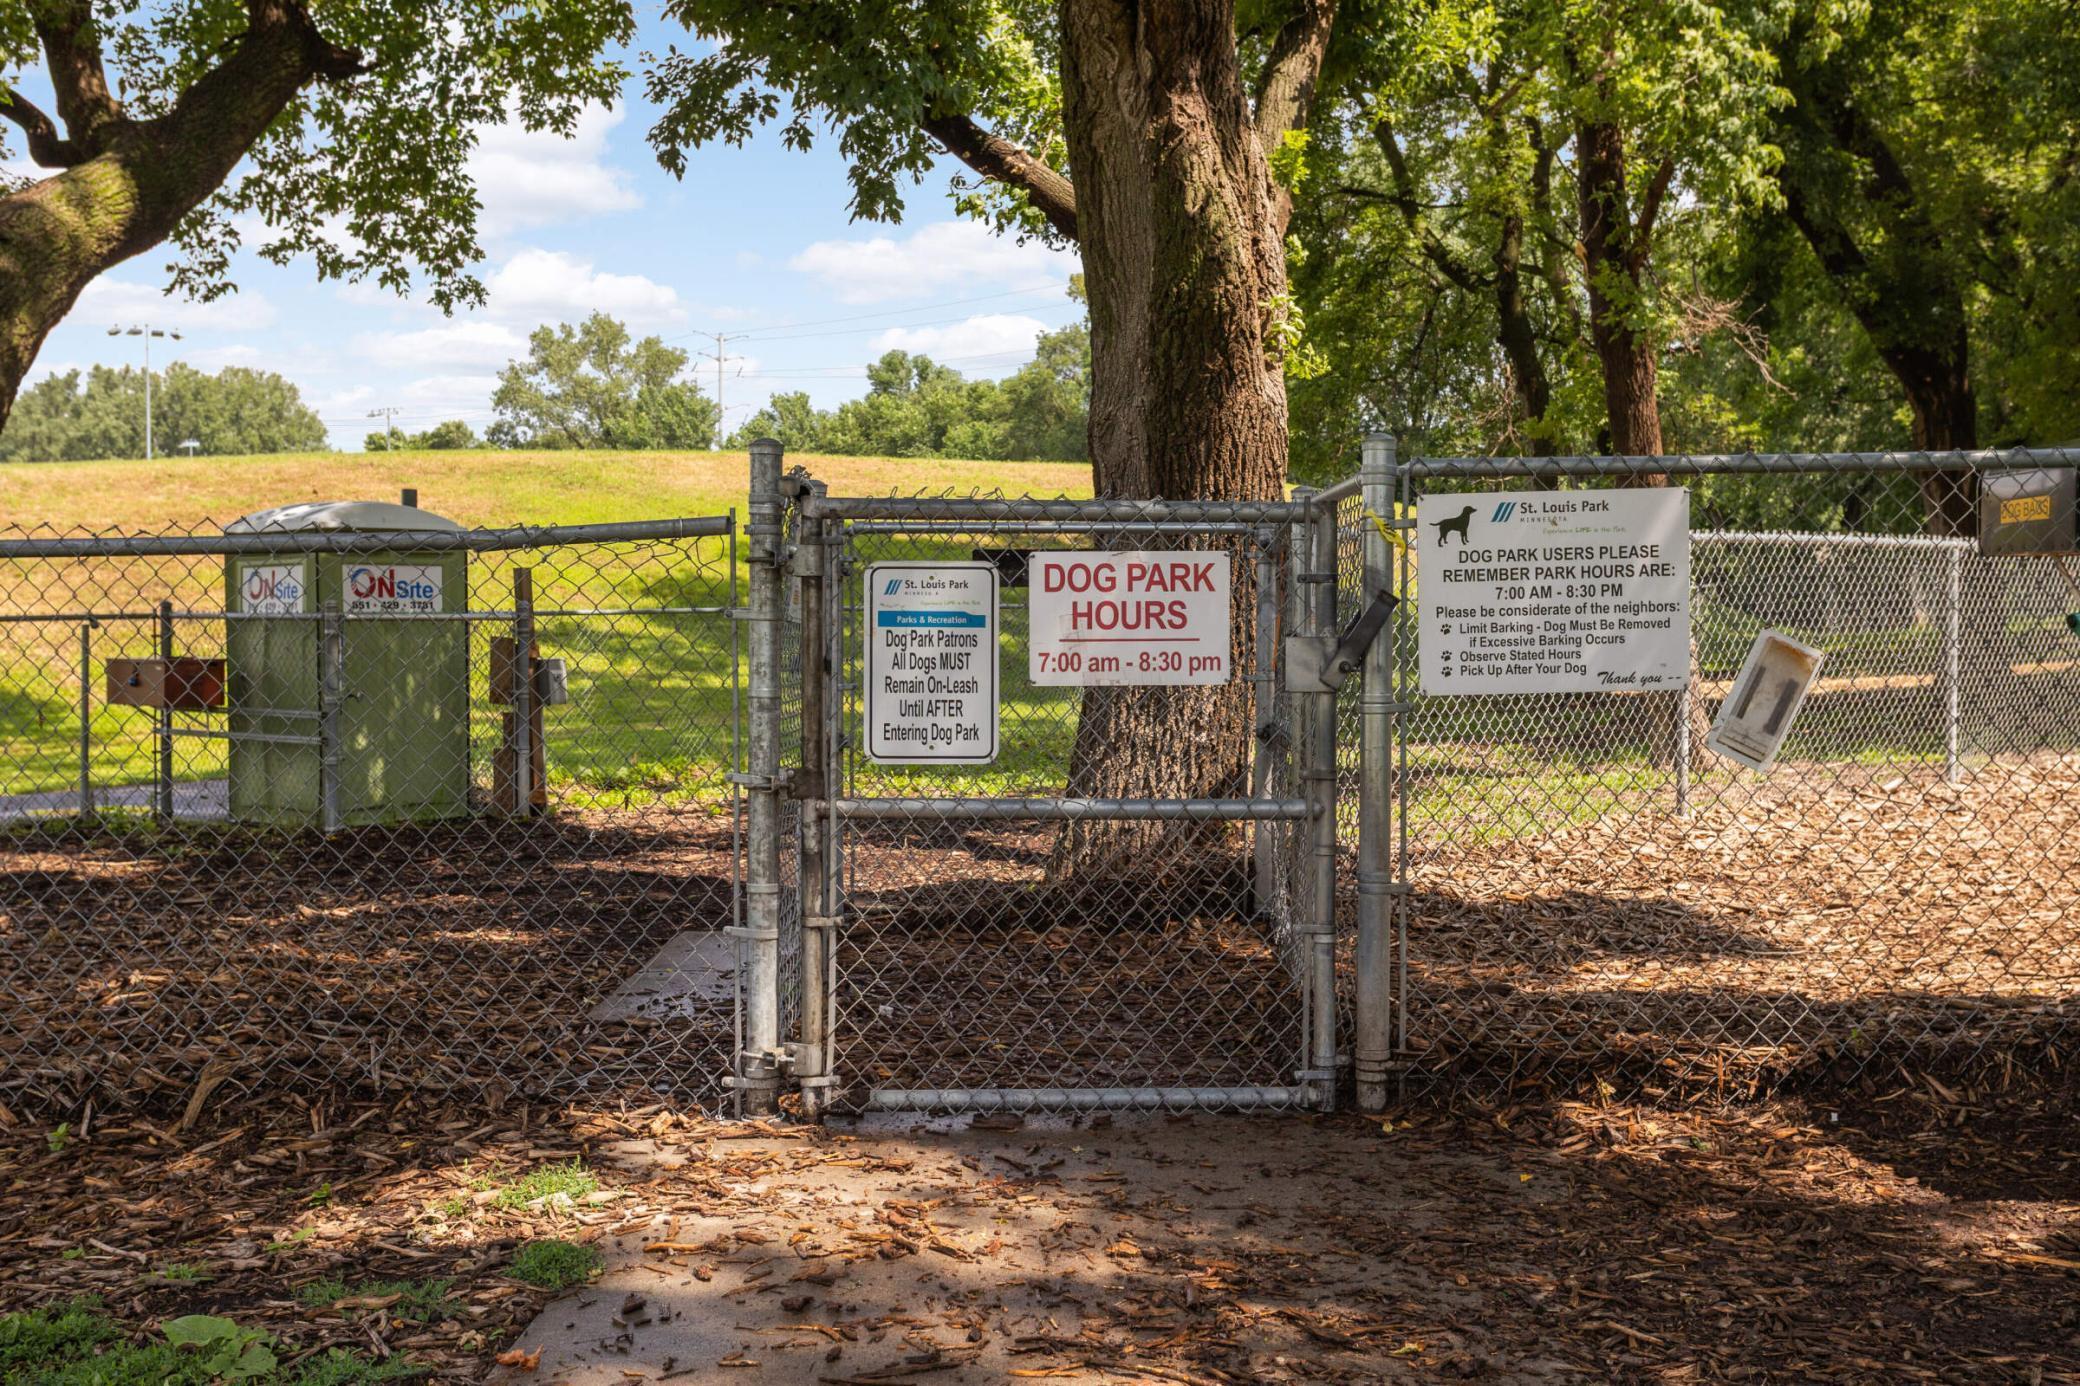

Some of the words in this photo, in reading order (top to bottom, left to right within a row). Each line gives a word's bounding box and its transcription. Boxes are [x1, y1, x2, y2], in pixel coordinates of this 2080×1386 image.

[1520, 502, 1537, 514] St.
[1542, 500, 1577, 513] Louis
[1581, 499, 1609, 512] Park
[1459, 549, 1492, 563] DOG
[1497, 548, 1538, 562] PARK
[1543, 546, 1594, 560] USERS
[1600, 545, 1660, 559] PLEASE
[1044, 563, 1117, 593] DOG
[1127, 563, 1216, 592] PARK
[1443, 567, 1530, 582] REMEMBER
[1535, 565, 1576, 580] PARK
[1581, 564, 1635, 579] HOURS
[1639, 563, 1676, 577] ARE:
[905, 580, 917, 589] St.
[921, 579, 946, 589] Louis
[949, 580, 969, 589] Park
[1496, 586, 1525, 600] 7:00
[1529, 585, 1552, 599] AM
[1566, 584, 1596, 598] 8:30
[1601, 583, 1623, 597] PM
[1072, 600, 1188, 630] HOURS
[1436, 606, 1476, 619] Please
[1480, 605, 1495, 617] be
[1499, 603, 1571, 617] considerate
[1575, 603, 1587, 615] of
[1590, 602, 1610, 614] the
[1614, 600, 1681, 616] neighbors:
[896, 616, 917, 624] Parks
[920, 616, 925, 624] &
[928, 615, 967, 624] Recreation
[1460, 622, 1488, 634] Limit
[1491, 621, 1534, 635] Barking
[1544, 620, 1566, 634] Dog
[1570, 619, 1597, 631] Must
[1600, 619, 1615, 630] Be
[1619, 617, 1671, 630] Removed
[886, 630, 907, 651] Dog
[910, 630, 934, 647] Park
[937, 630, 978, 647] Patrons
[1469, 636, 1477, 648] if
[1480, 635, 1535, 647] Excessive
[1539, 634, 1582, 648] Barking
[1585, 633, 1626, 645] Occurs
[892, 652, 906, 670] All
[909, 652, 937, 674] Dogs
[940, 652, 971, 670] MUST
[1038, 652, 1082, 673] 7:00
[1088, 655, 1120, 673] am
[1139, 651, 1182, 671] 8:30
[1188, 654, 1221, 676] pm
[1460, 650, 1506, 662] Observe
[1510, 649, 1545, 661] Stated
[1548, 648, 1582, 660] Hours
[1460, 664, 1484, 676] Pick
[1488, 664, 1503, 678] Up
[1506, 663, 1533, 675] After
[1536, 662, 1562, 674] Your
[1564, 662, 1587, 675] Dog
[1597, 671, 1636, 685] Thank
[1640, 674, 1662, 687] you
[885, 676, 924, 693] Remain
[927, 676, 978, 694] On-Leash
[900, 700, 924, 717] Until
[926, 700, 963, 717] AFTER
[883, 723, 928, 745] Entering
[931, 723, 952, 745] Dog
[956, 723, 979, 740] Park
